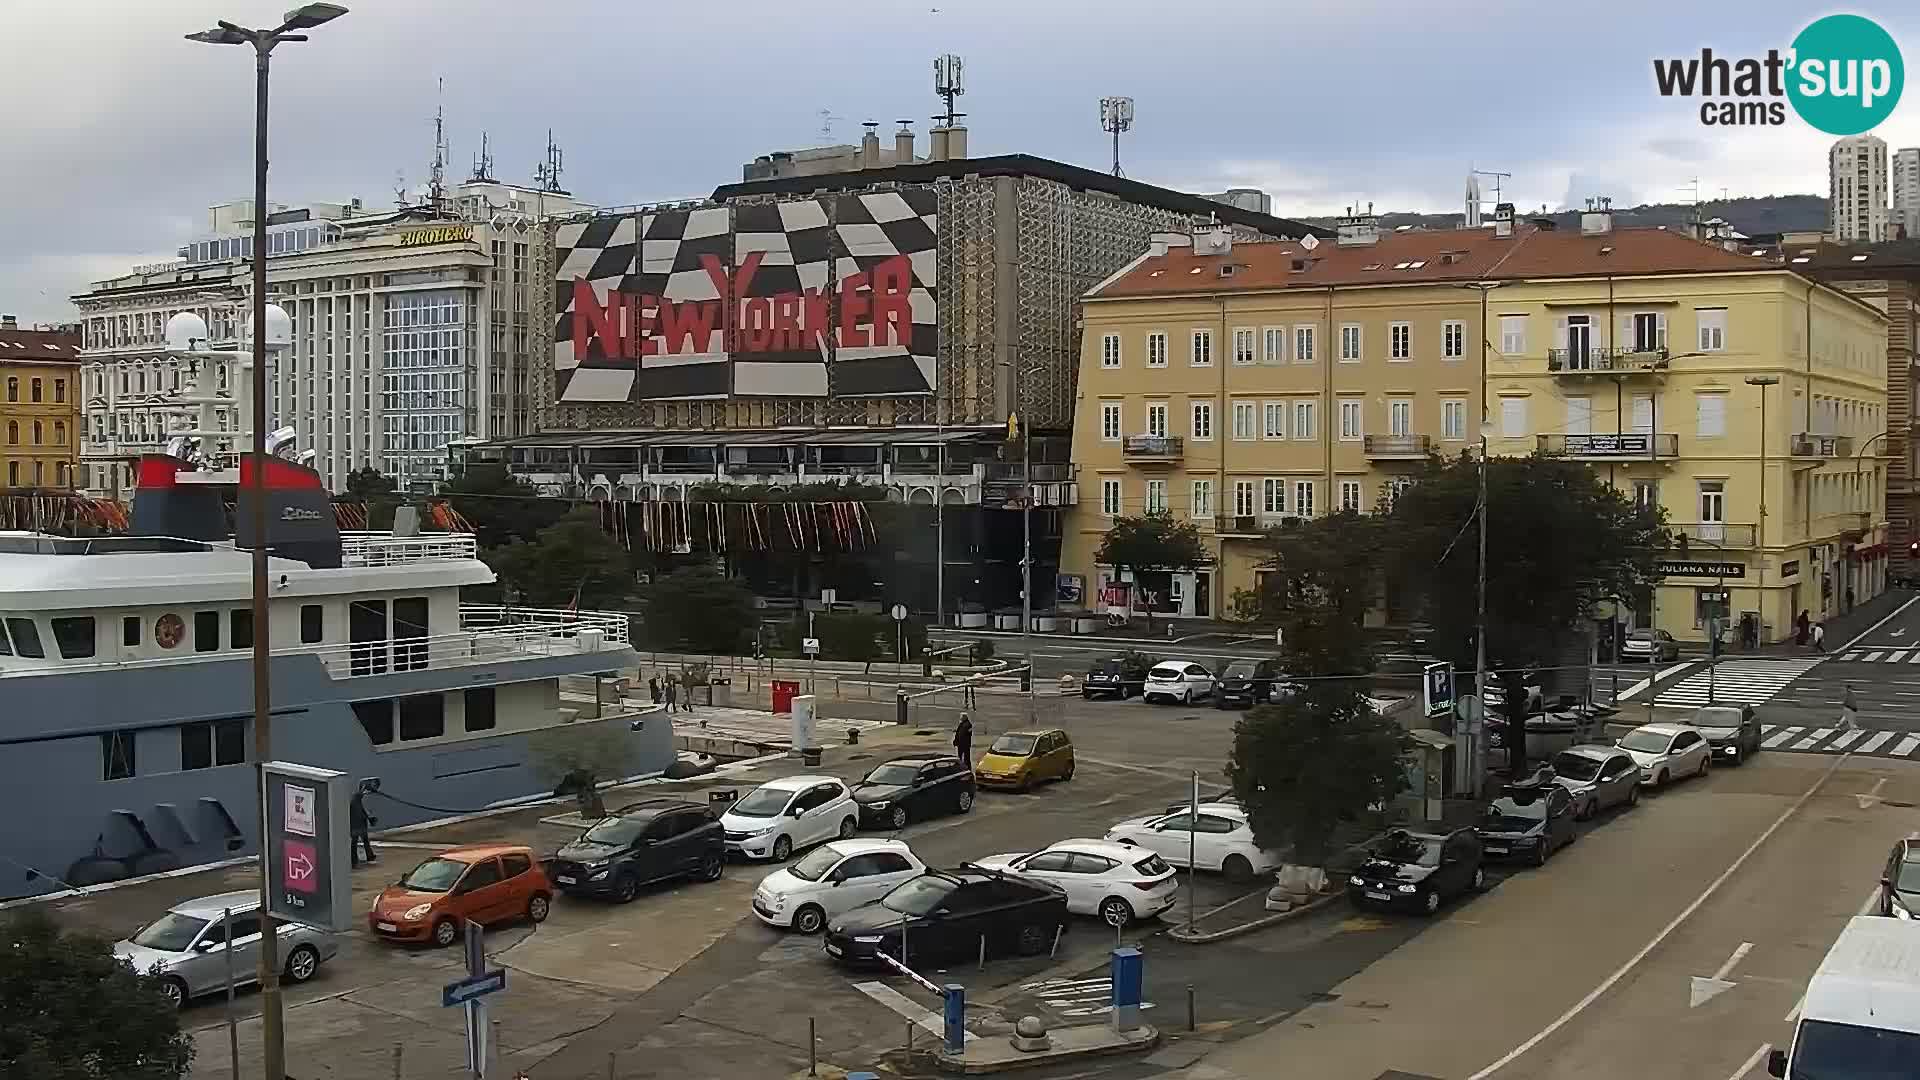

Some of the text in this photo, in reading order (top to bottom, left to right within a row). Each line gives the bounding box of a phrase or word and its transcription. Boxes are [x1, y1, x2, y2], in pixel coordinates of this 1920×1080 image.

[573, 250, 912, 360] NEW YORKER
[1708, 566, 1741, 574] NAILS
[1434, 670, 1446, 693] P
[286, 893, 292, 904] 5
